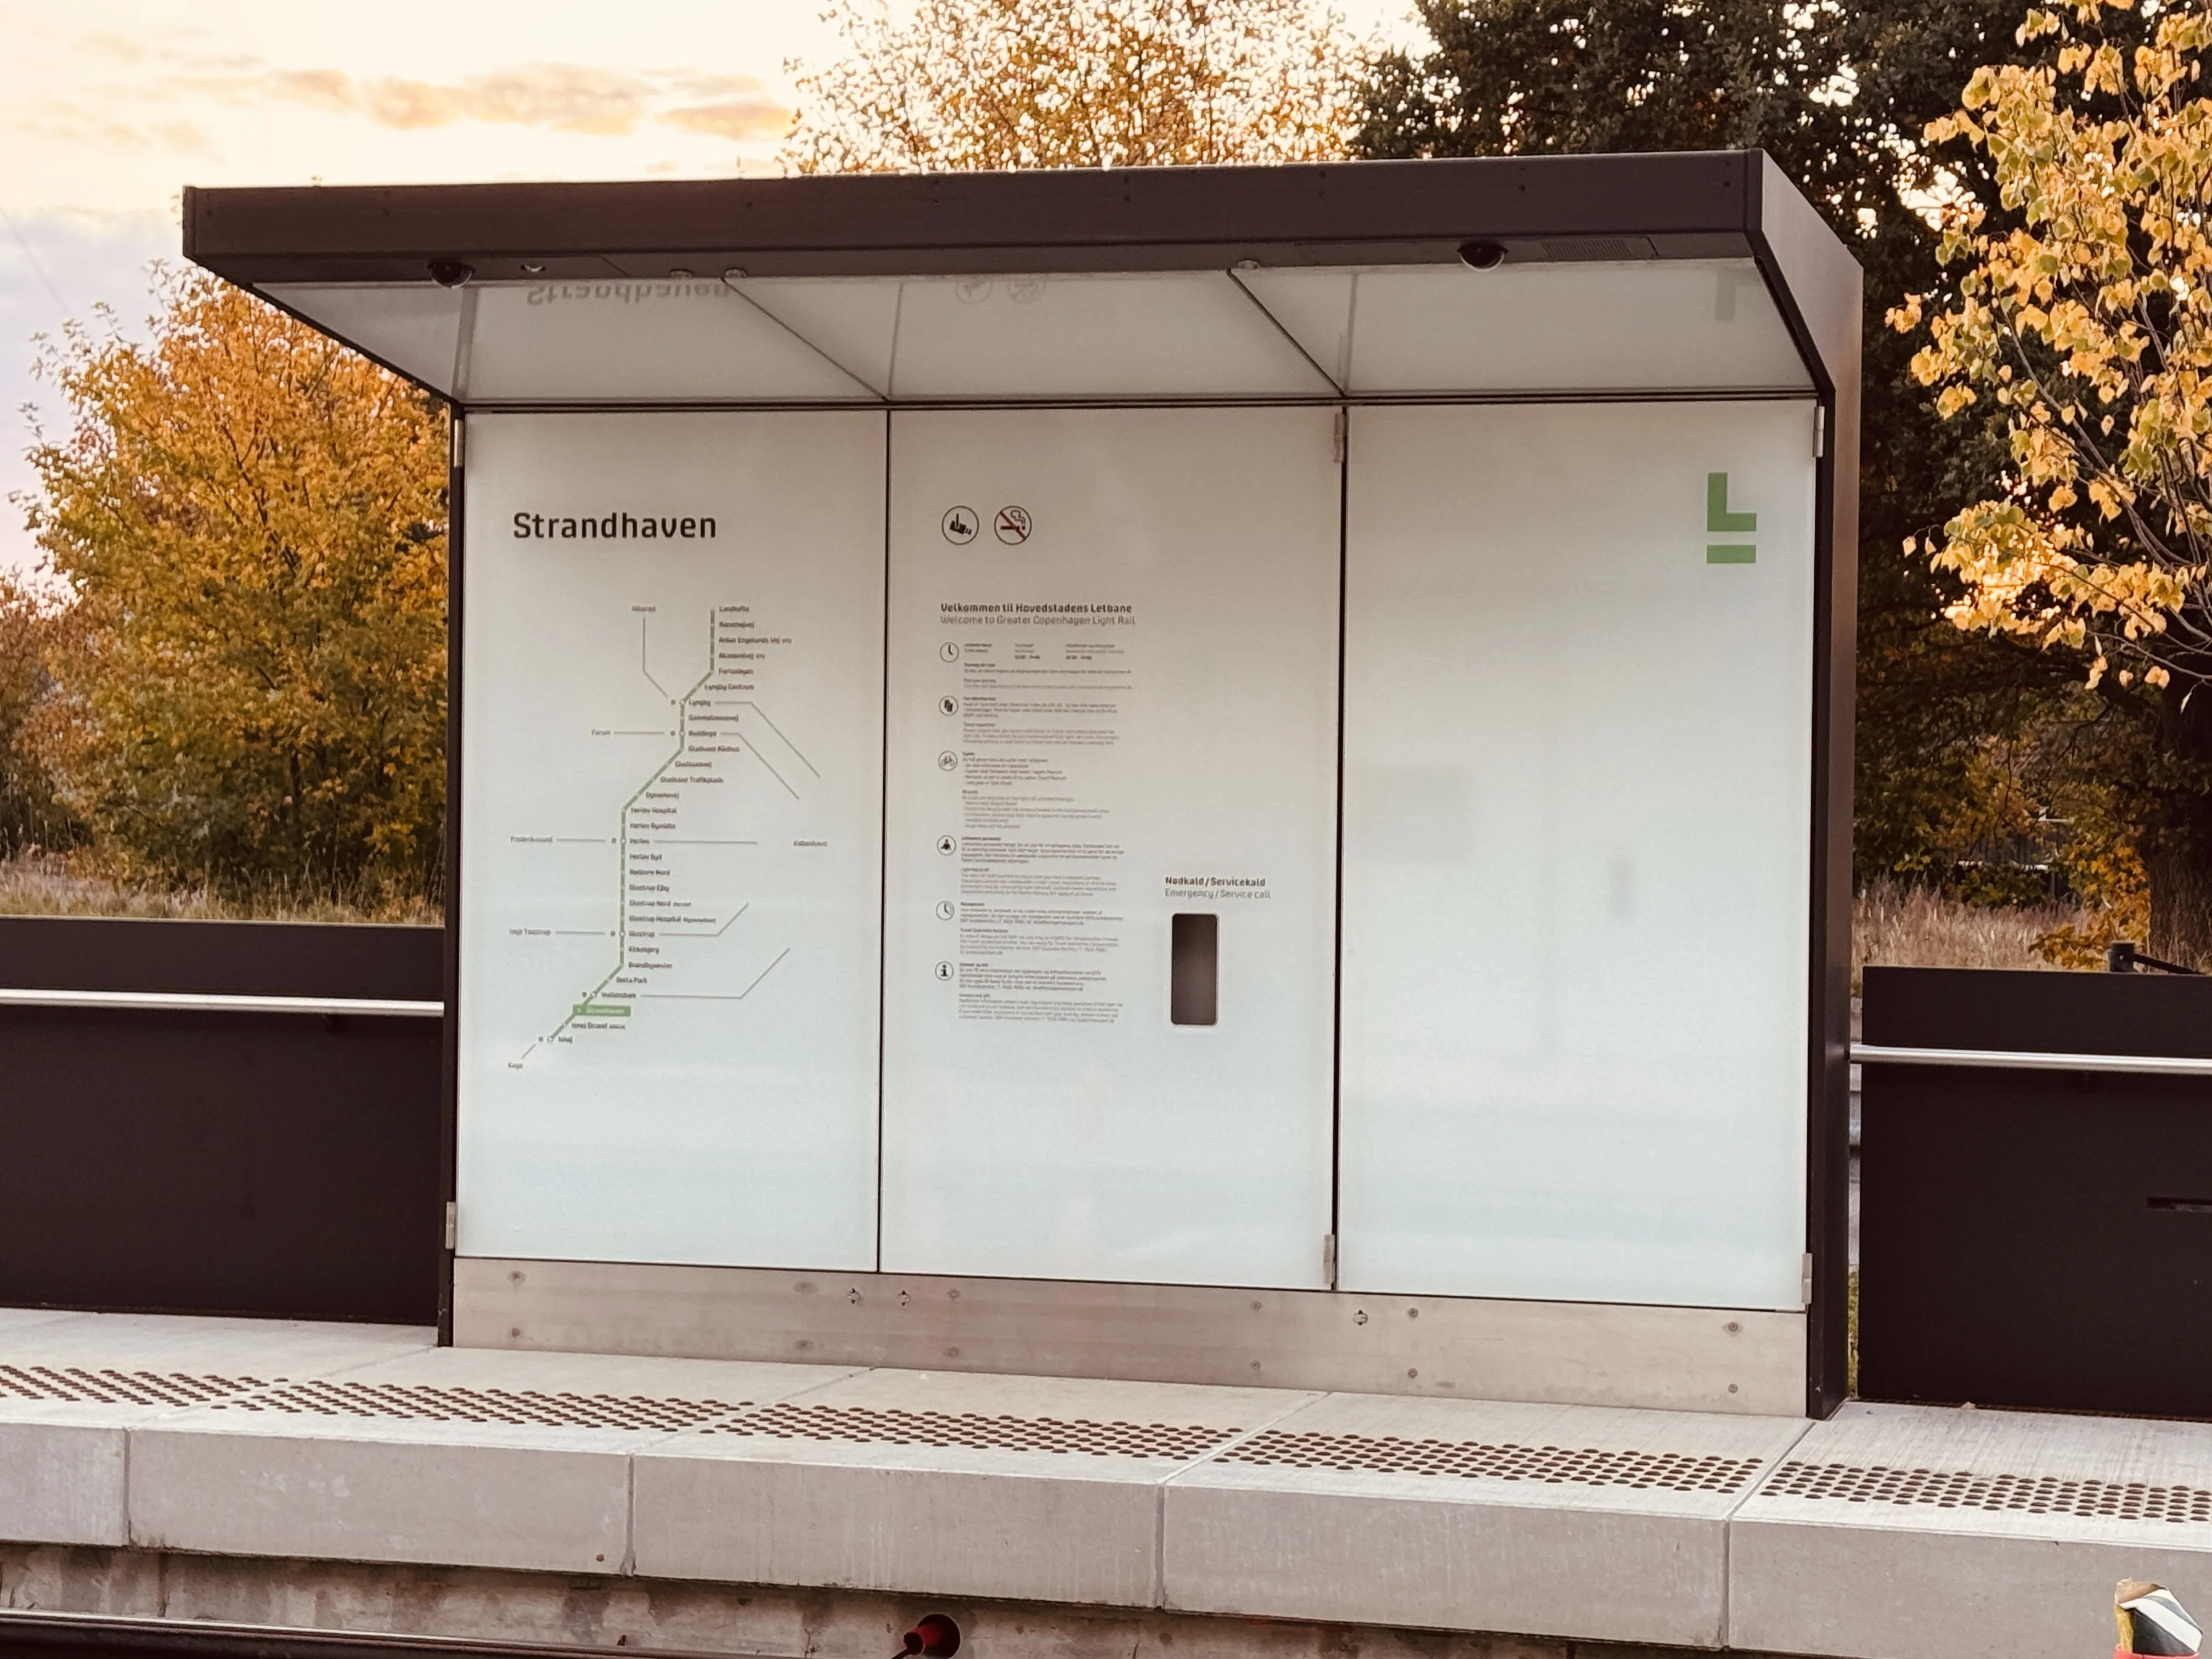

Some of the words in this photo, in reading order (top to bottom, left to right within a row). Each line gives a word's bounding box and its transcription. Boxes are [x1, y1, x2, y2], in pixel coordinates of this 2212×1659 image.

[514, 512, 716, 539] Strandhaven
[941, 602, 1001, 613] Velkommen
[1002, 603, 1014, 613] til
[1016, 603, 1089, 613] Hovedstadens
[1091, 603, 1132, 613] Letbane
[940, 615, 983, 625] Welcome
[985, 616, 995, 624] to
[996, 615, 1031, 625] Greater
[1033, 615, 1091, 627] Copenhagen
[1092, 616, 1116, 627] Light
[1118, 616, 1136, 625] Rail
